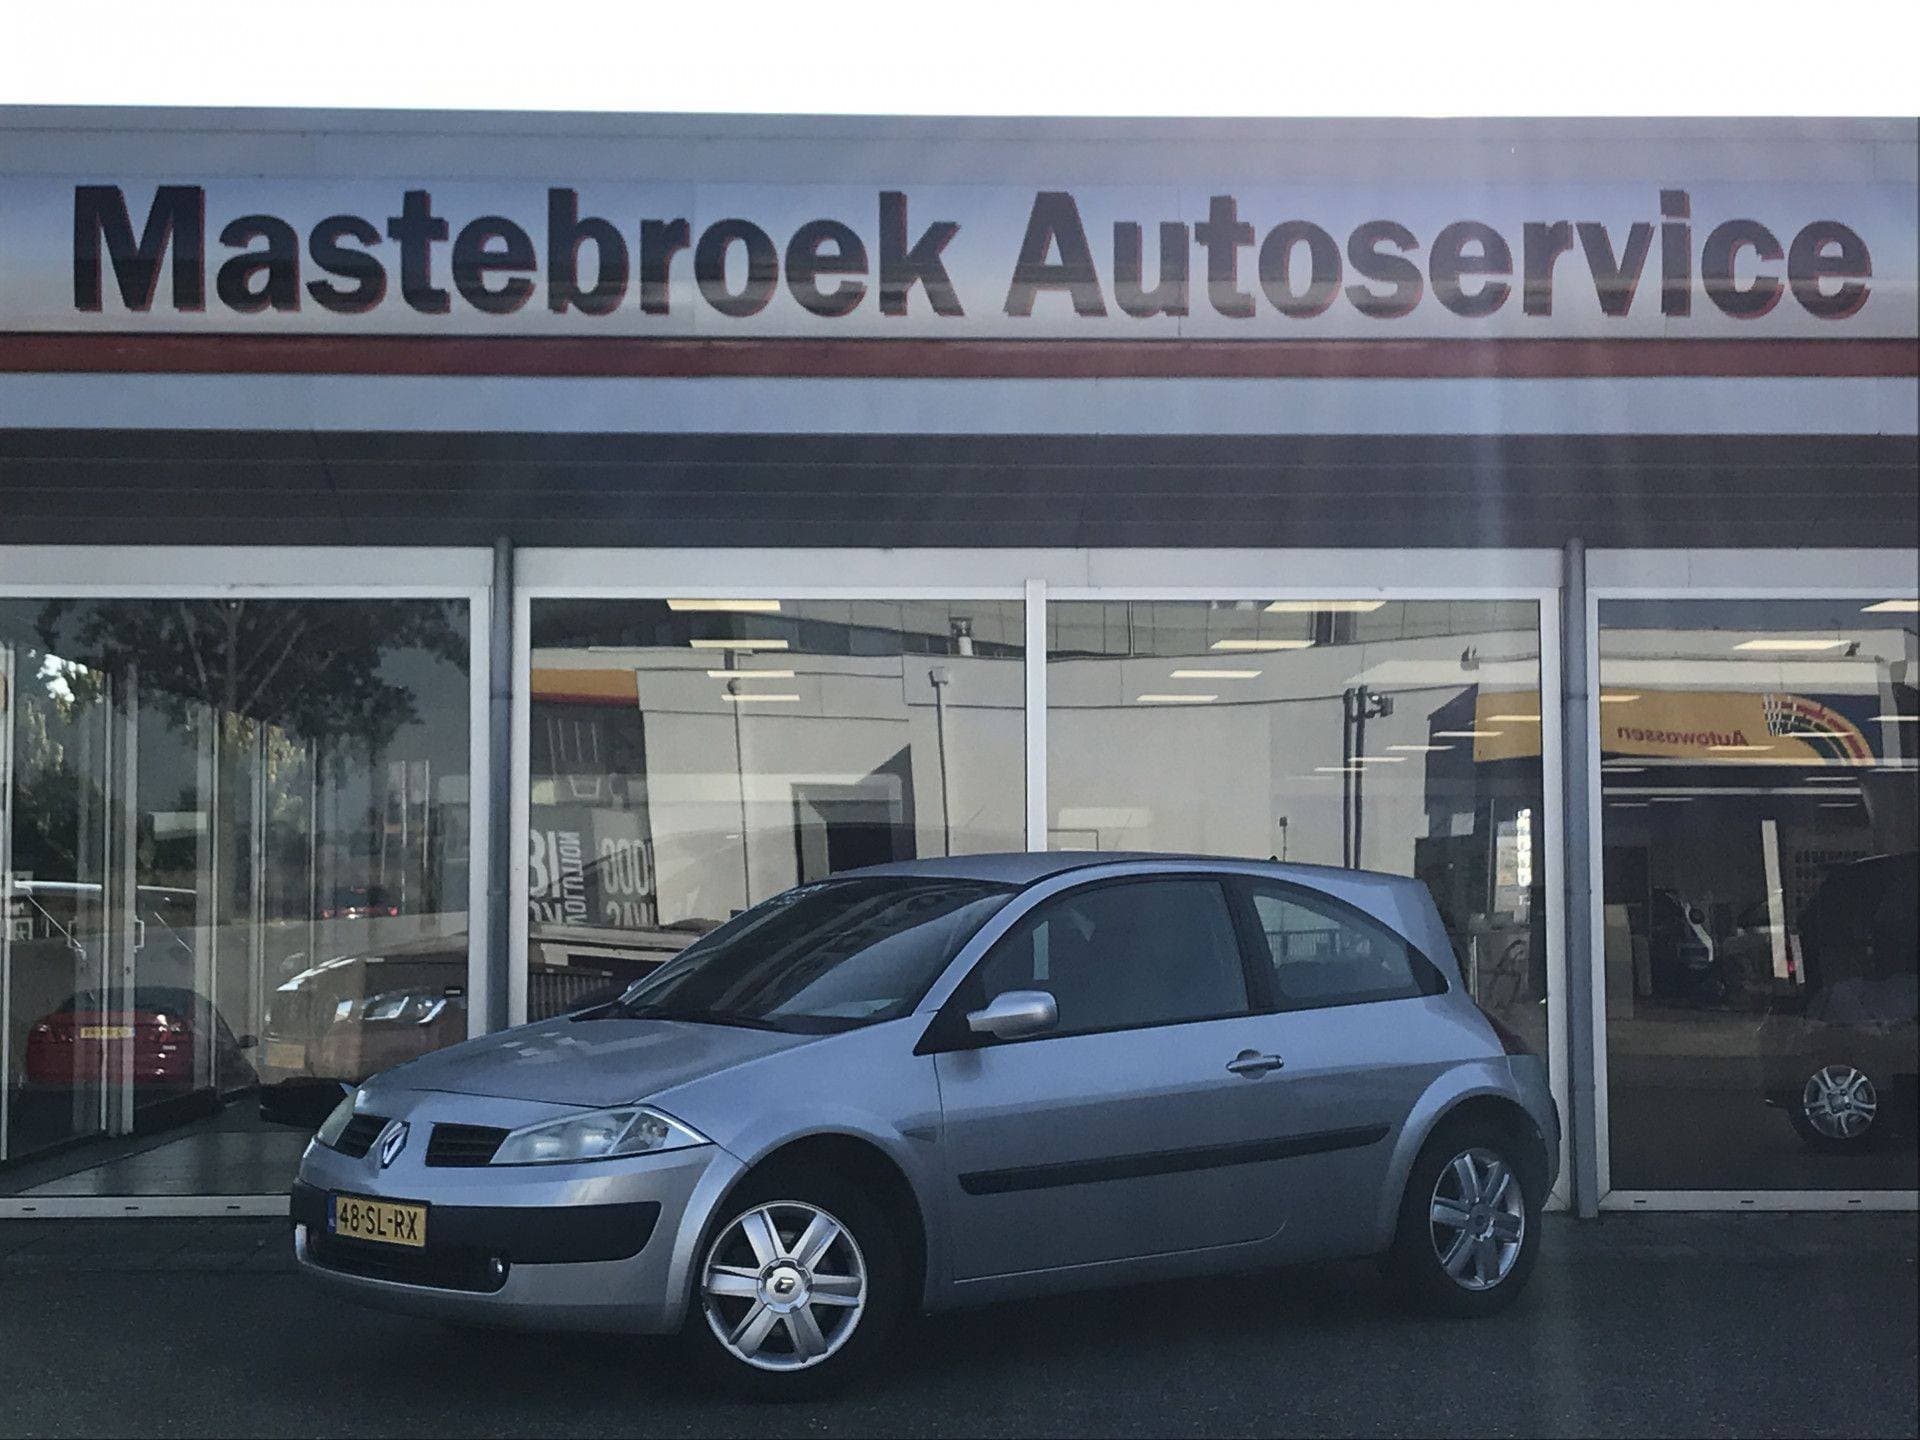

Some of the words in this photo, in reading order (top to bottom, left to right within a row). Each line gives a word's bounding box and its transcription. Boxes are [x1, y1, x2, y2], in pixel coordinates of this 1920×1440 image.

[73, 184, 967, 318] Mastebroek
[1002, 189, 1874, 320] Autoservice
[339, 1202, 418, 1241] 48-SL-RX
